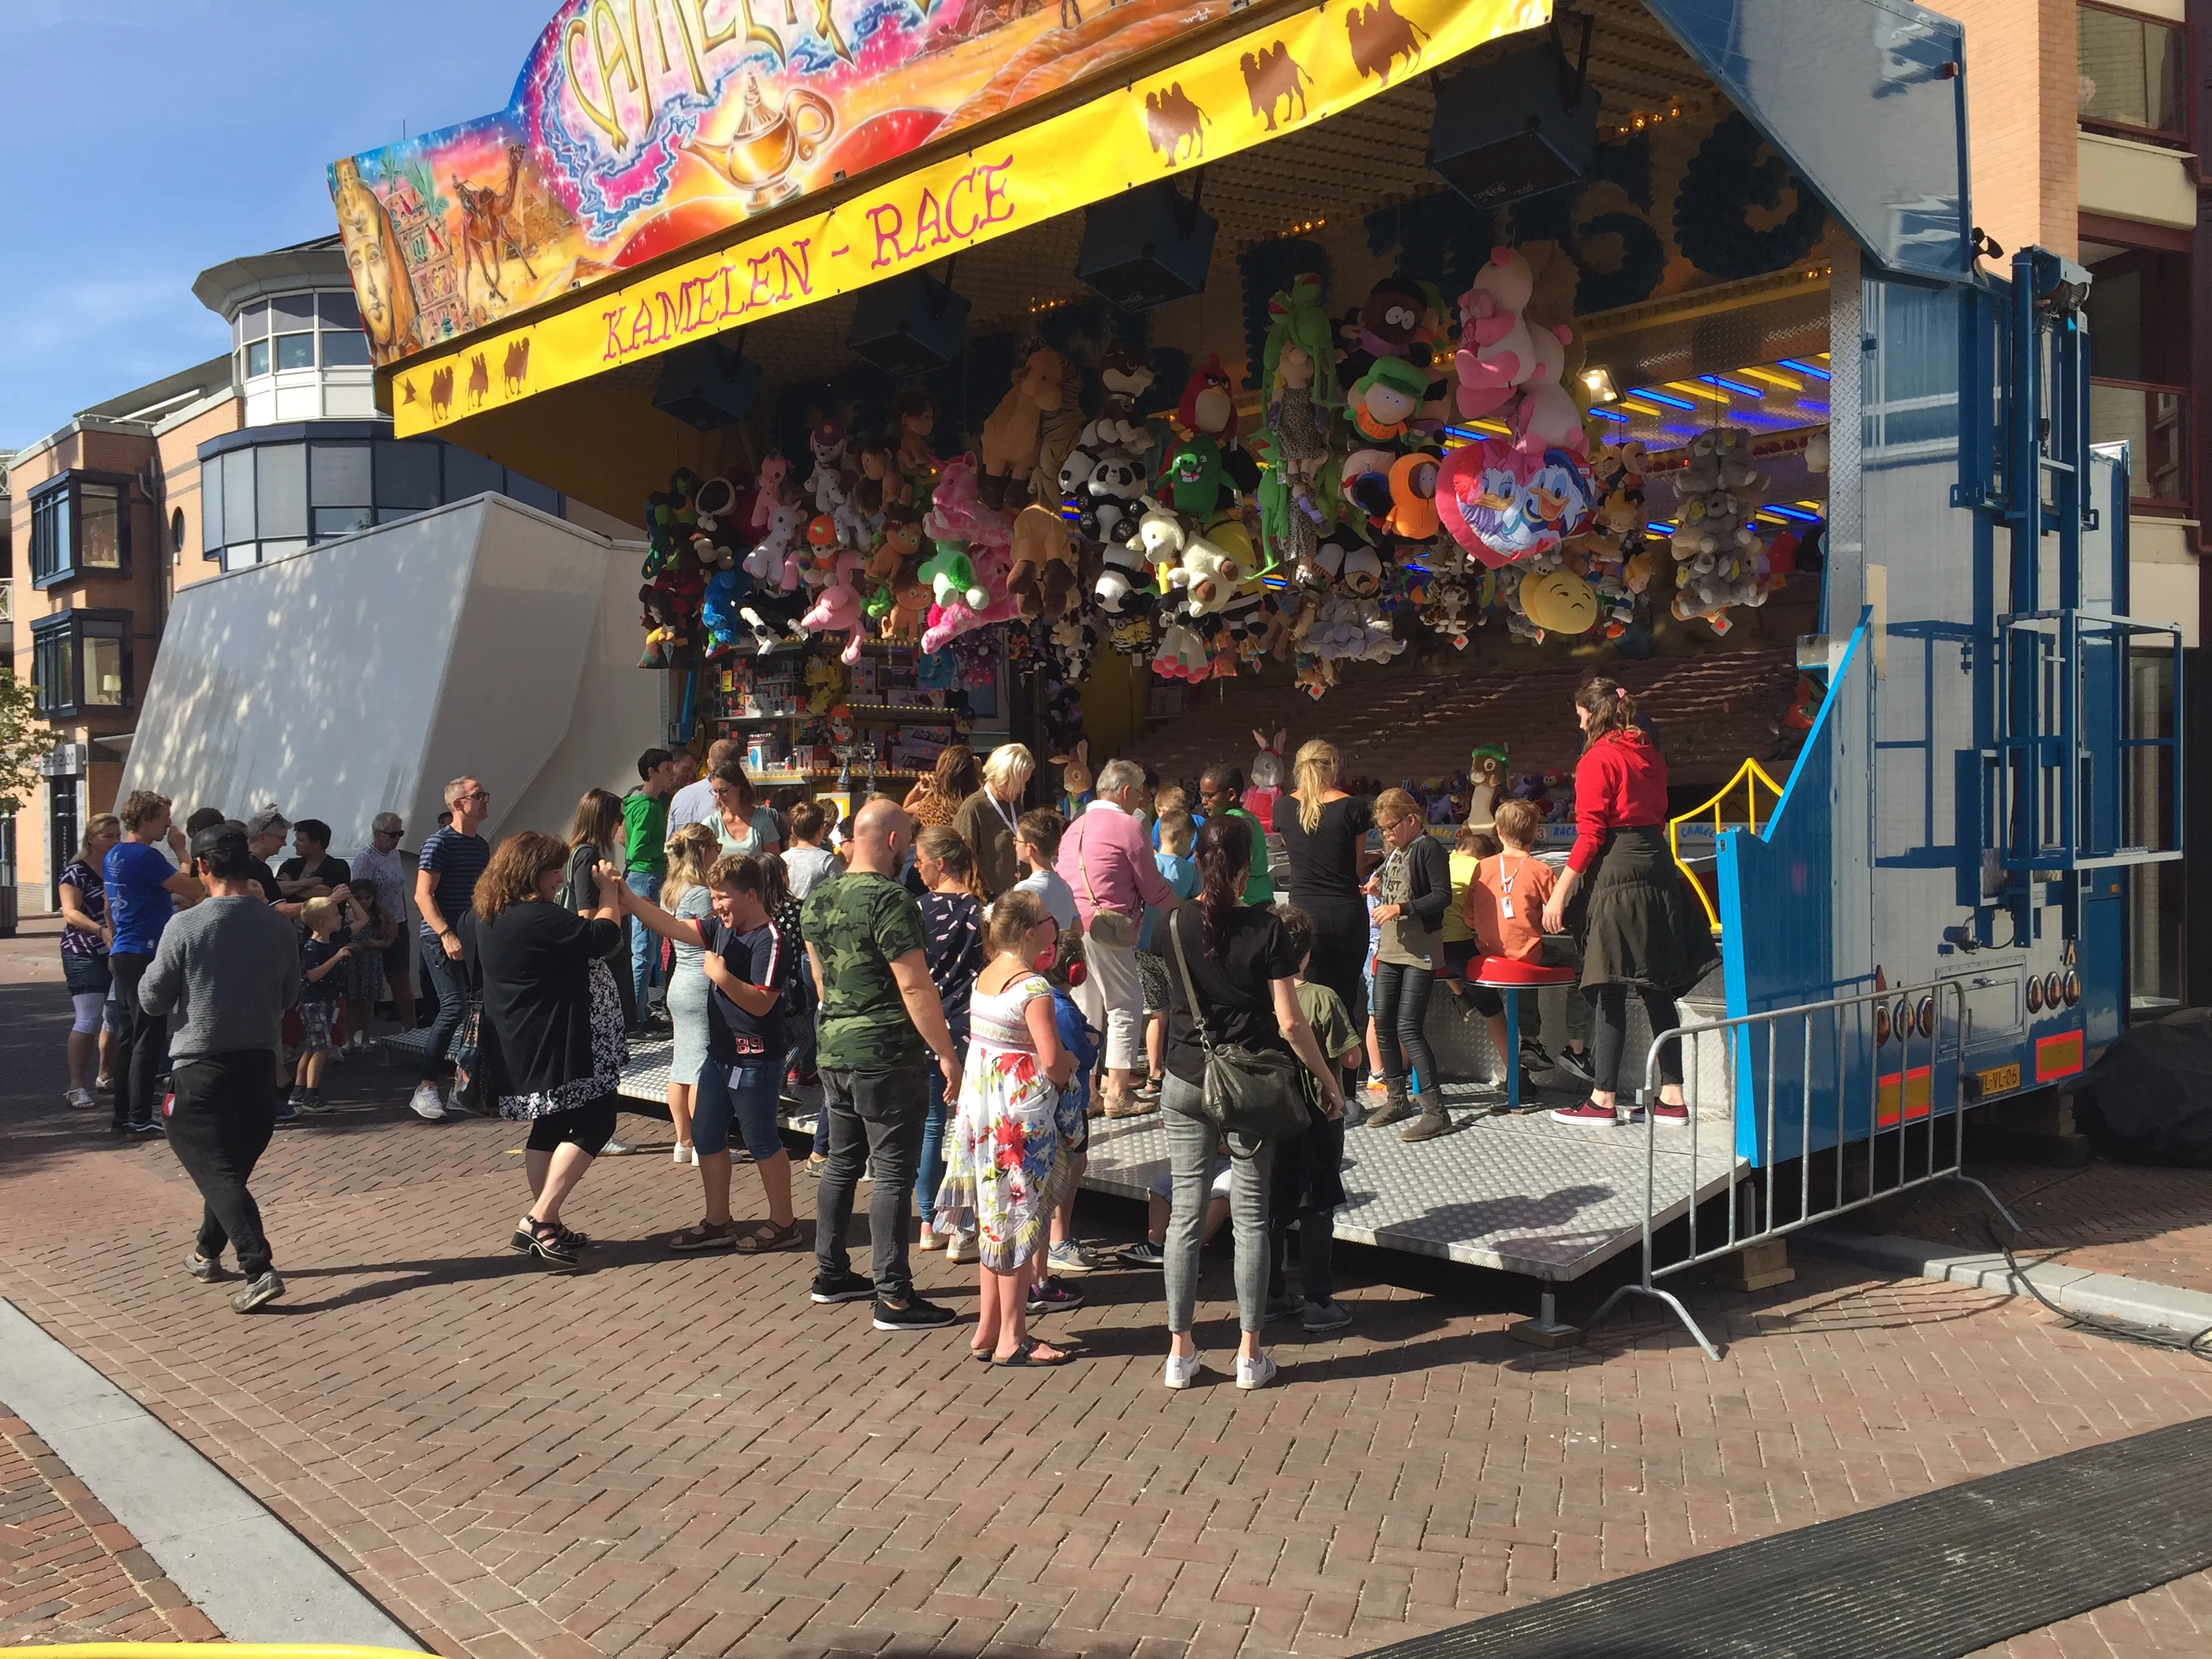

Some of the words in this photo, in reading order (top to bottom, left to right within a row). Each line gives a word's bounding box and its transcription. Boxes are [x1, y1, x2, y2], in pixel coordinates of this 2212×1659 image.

[602, 237, 813, 361] KAMELEN
[865, 154, 1015, 270] RACE
[1537, 829, 1544, 840] 3
[1681, 825, 1715, 838] CAMEL
[735, 1036, 764, 1054] 89
[1983, 1067, 2017, 1090] L-VL-06
